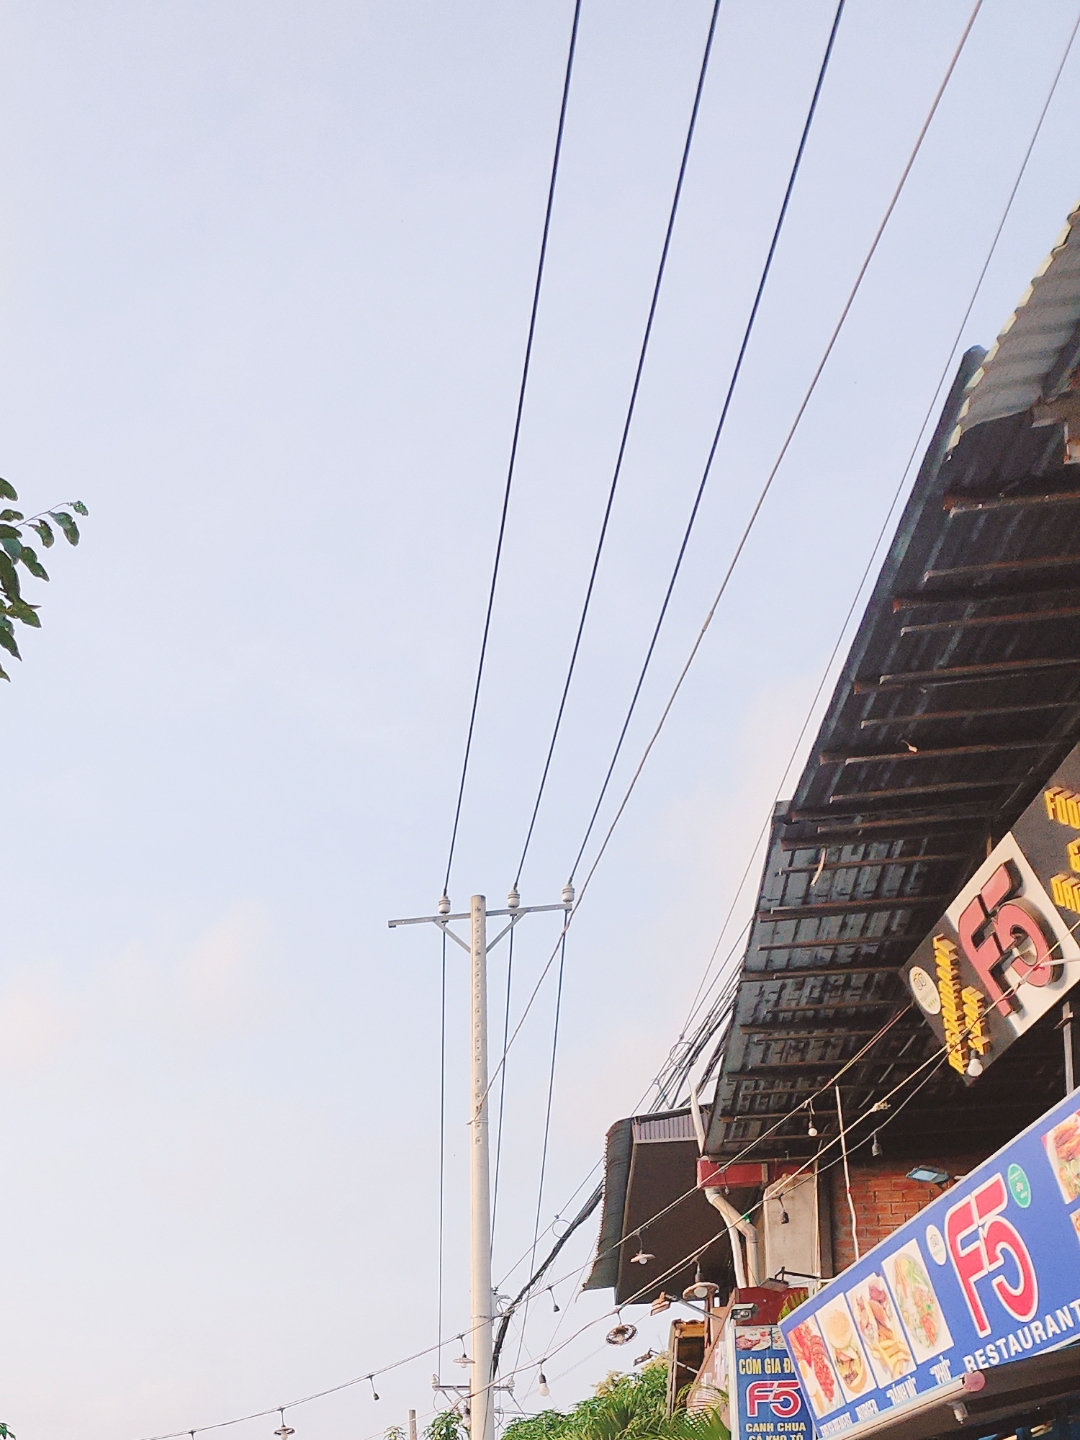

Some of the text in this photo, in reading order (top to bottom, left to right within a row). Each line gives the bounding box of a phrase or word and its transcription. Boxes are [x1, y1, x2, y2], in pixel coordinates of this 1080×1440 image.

[1044, 786, 1080, 830] FOO
[1051, 873, 1080, 916] DRI
[958, 862, 1053, 1018] F5
[945, 1171, 1039, 1338] F5
[963, 1298, 1080, 1374] RESTAURANT
[739, 1357, 761, 1374] CƠM
[764, 1358, 781, 1374] GIA
[746, 1379, 802, 1418] F5
[746, 1422, 806, 1432] CANH CHUA
